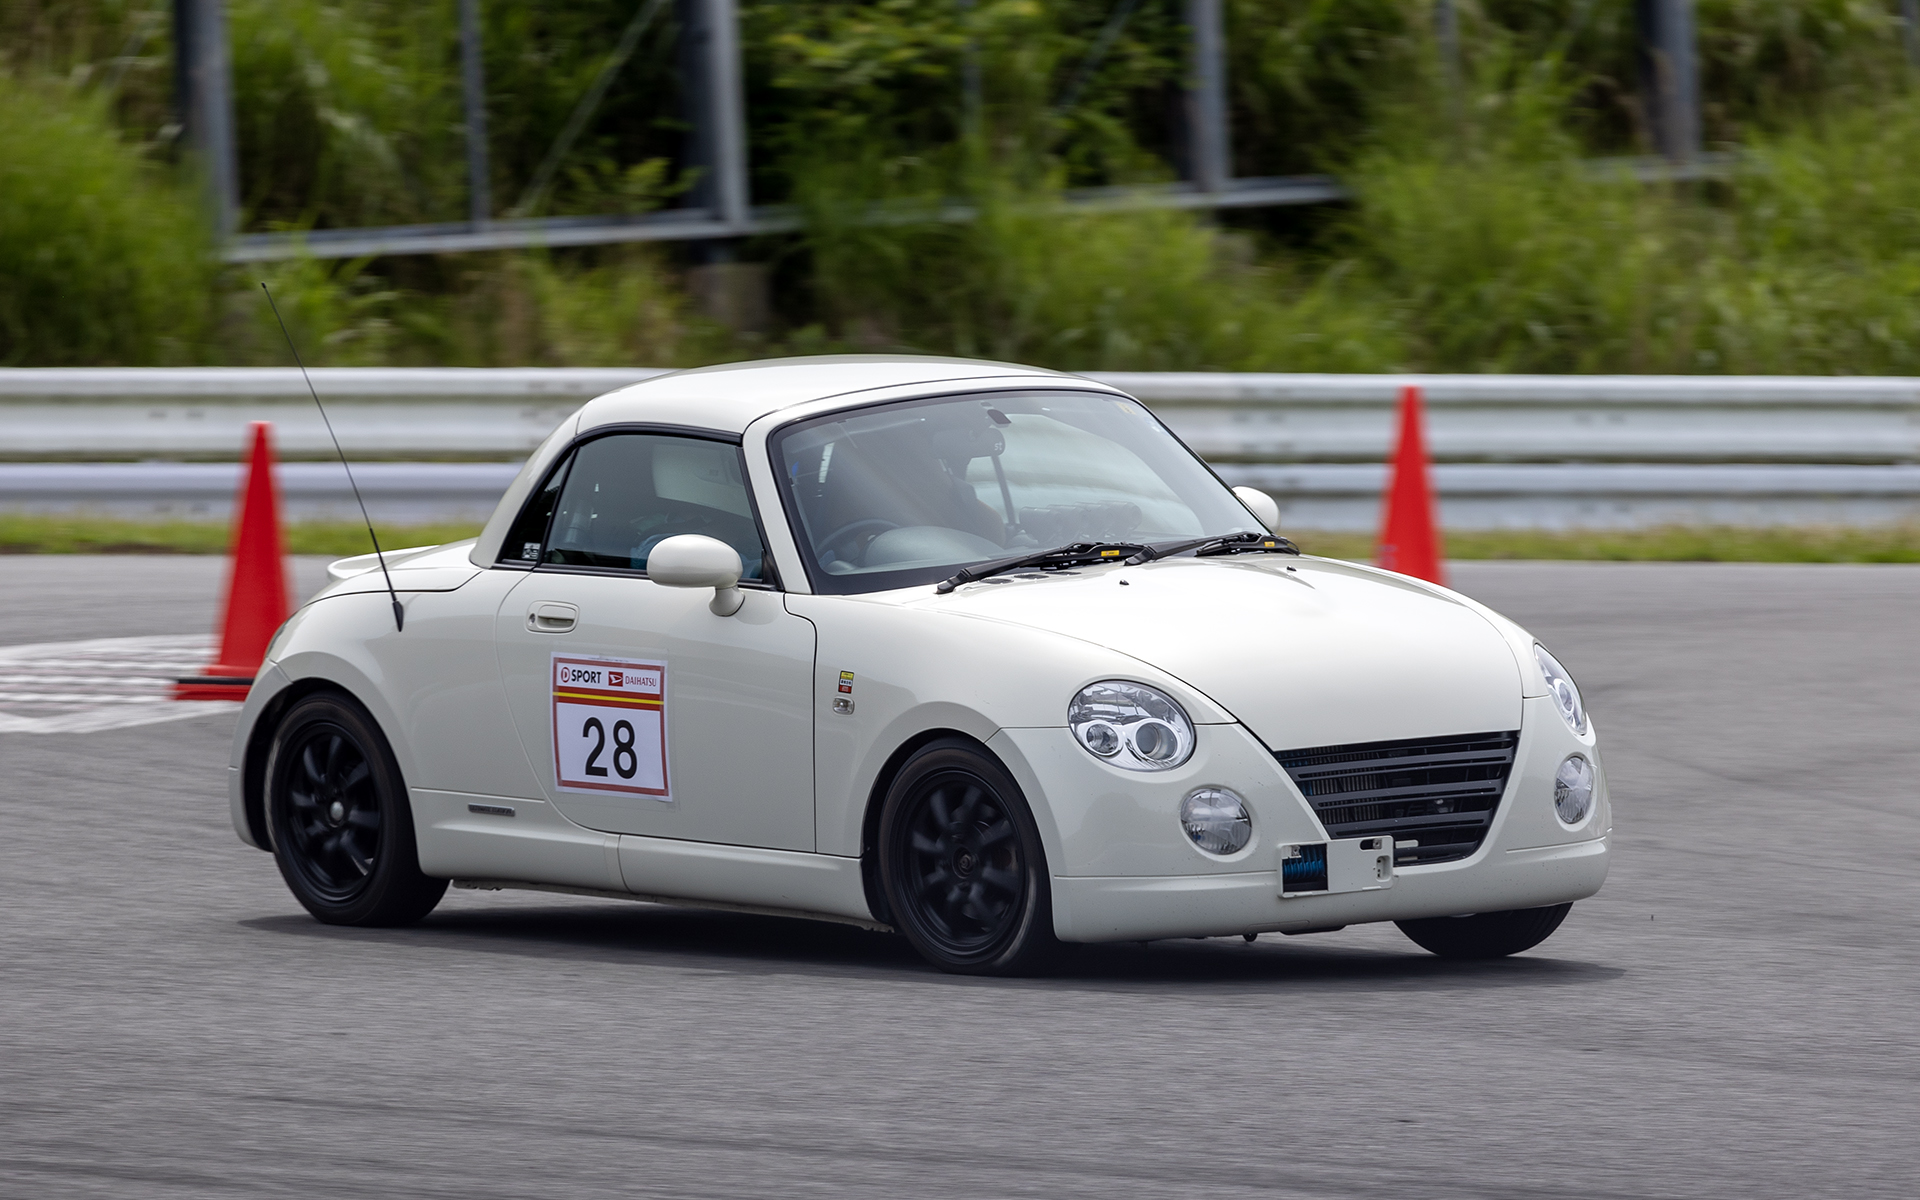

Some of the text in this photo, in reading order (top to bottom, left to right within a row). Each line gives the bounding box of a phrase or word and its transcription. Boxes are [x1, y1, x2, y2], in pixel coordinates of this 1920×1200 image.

[571, 669, 602, 684] SPORT
[625, 675, 657, 687] DAIHATSU
[582, 717, 637, 780] 28
